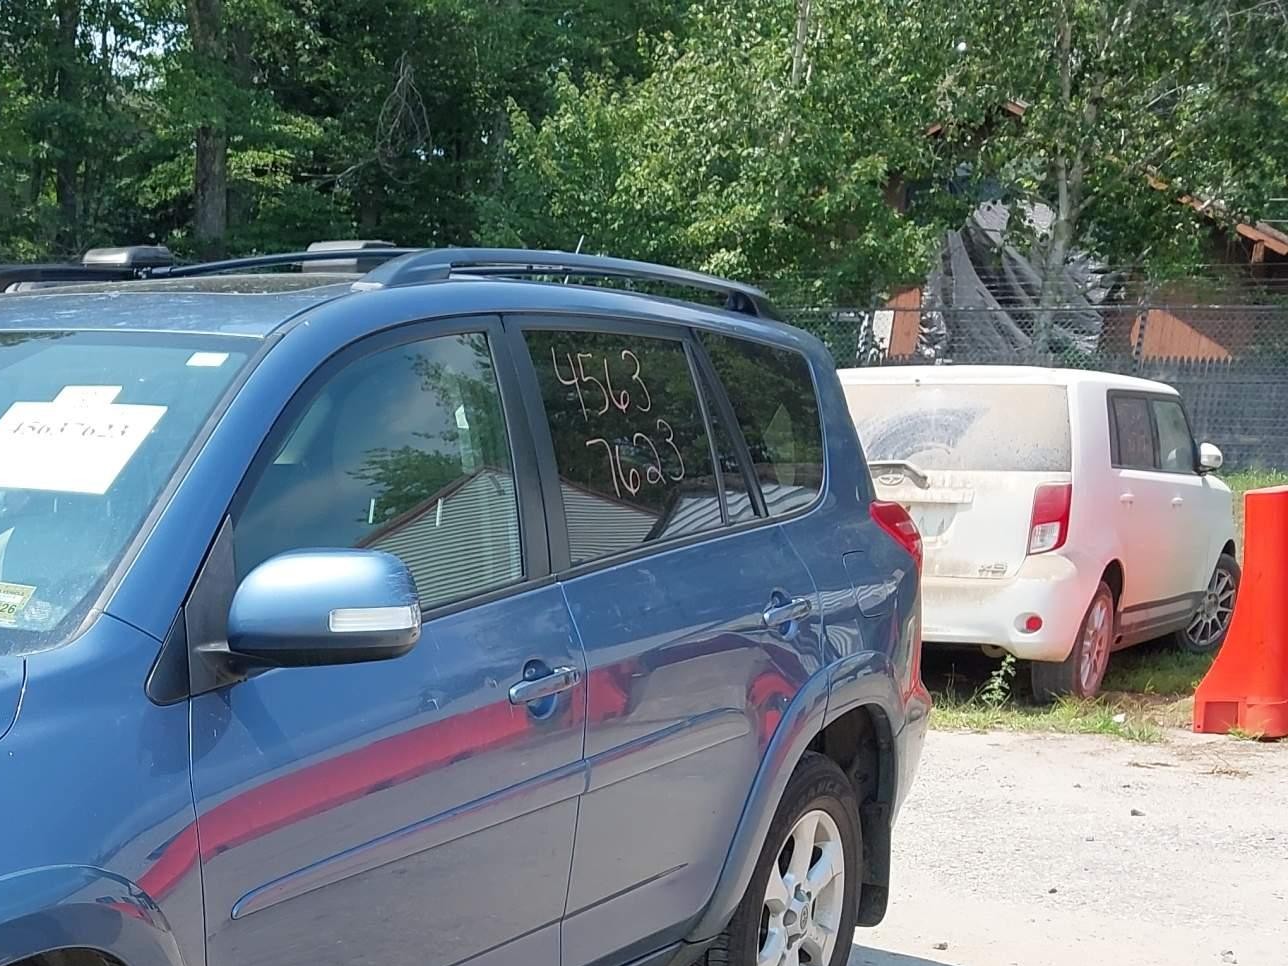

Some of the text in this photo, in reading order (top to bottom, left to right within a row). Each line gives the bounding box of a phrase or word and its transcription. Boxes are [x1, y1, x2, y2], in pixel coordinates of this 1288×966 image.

[551, 346, 652, 422] 4563
[585, 418, 686, 499] 7623
[0, 603, 17, 614] 26
